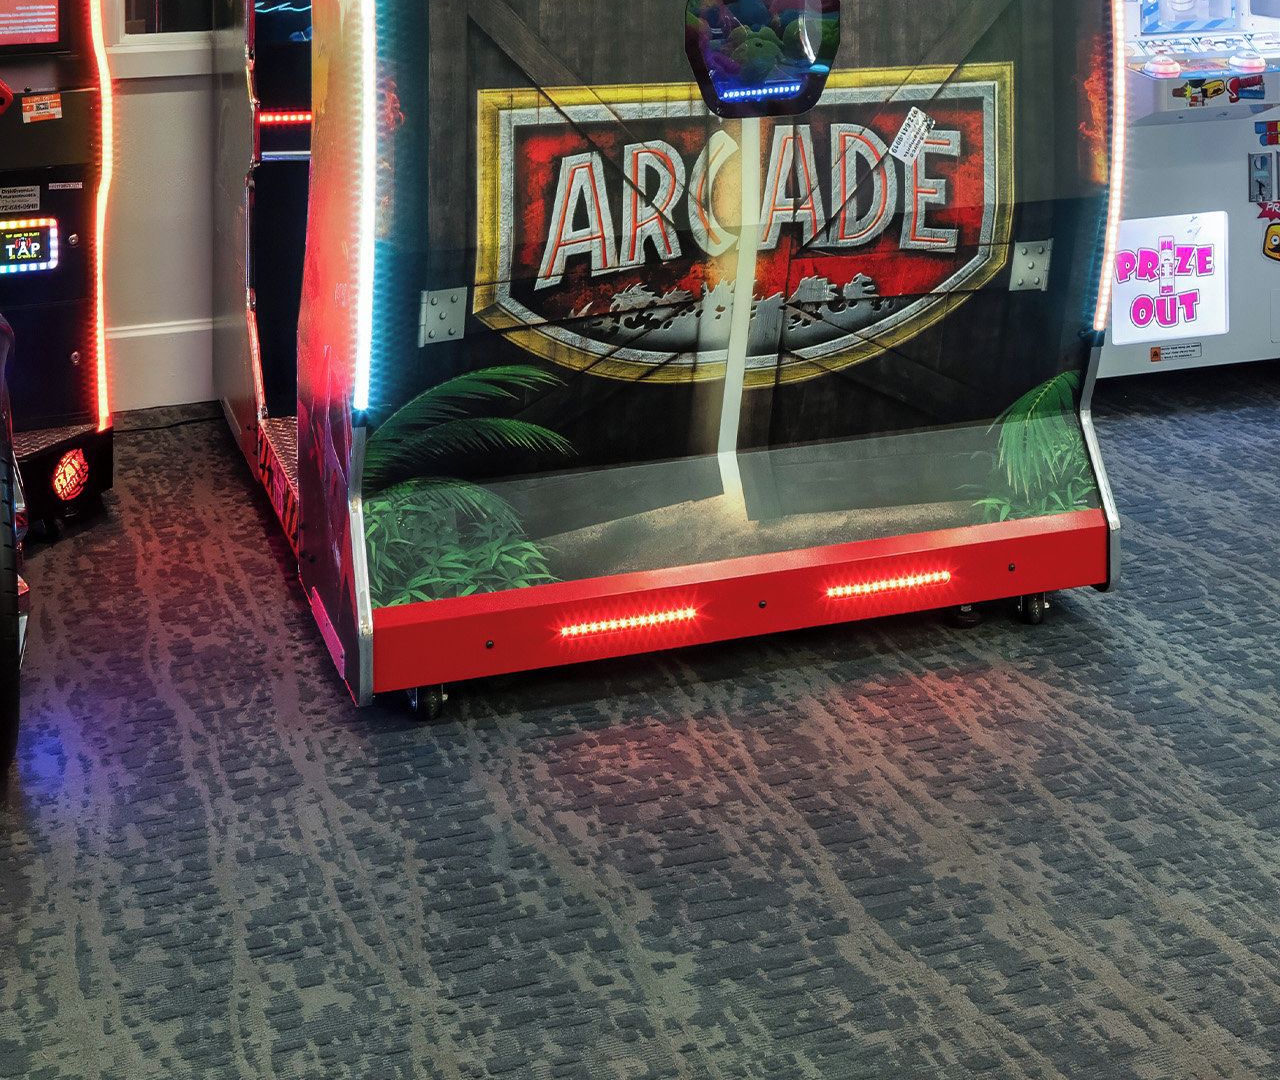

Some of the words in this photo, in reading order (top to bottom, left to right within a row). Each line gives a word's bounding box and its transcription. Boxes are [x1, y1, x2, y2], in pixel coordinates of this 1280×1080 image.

[533, 123, 960, 291] ARCADE
[5, 241, 40, 258] TAP
[1114, 236, 1215, 296] PRIZE
[1130, 289, 1200, 328] OUT
